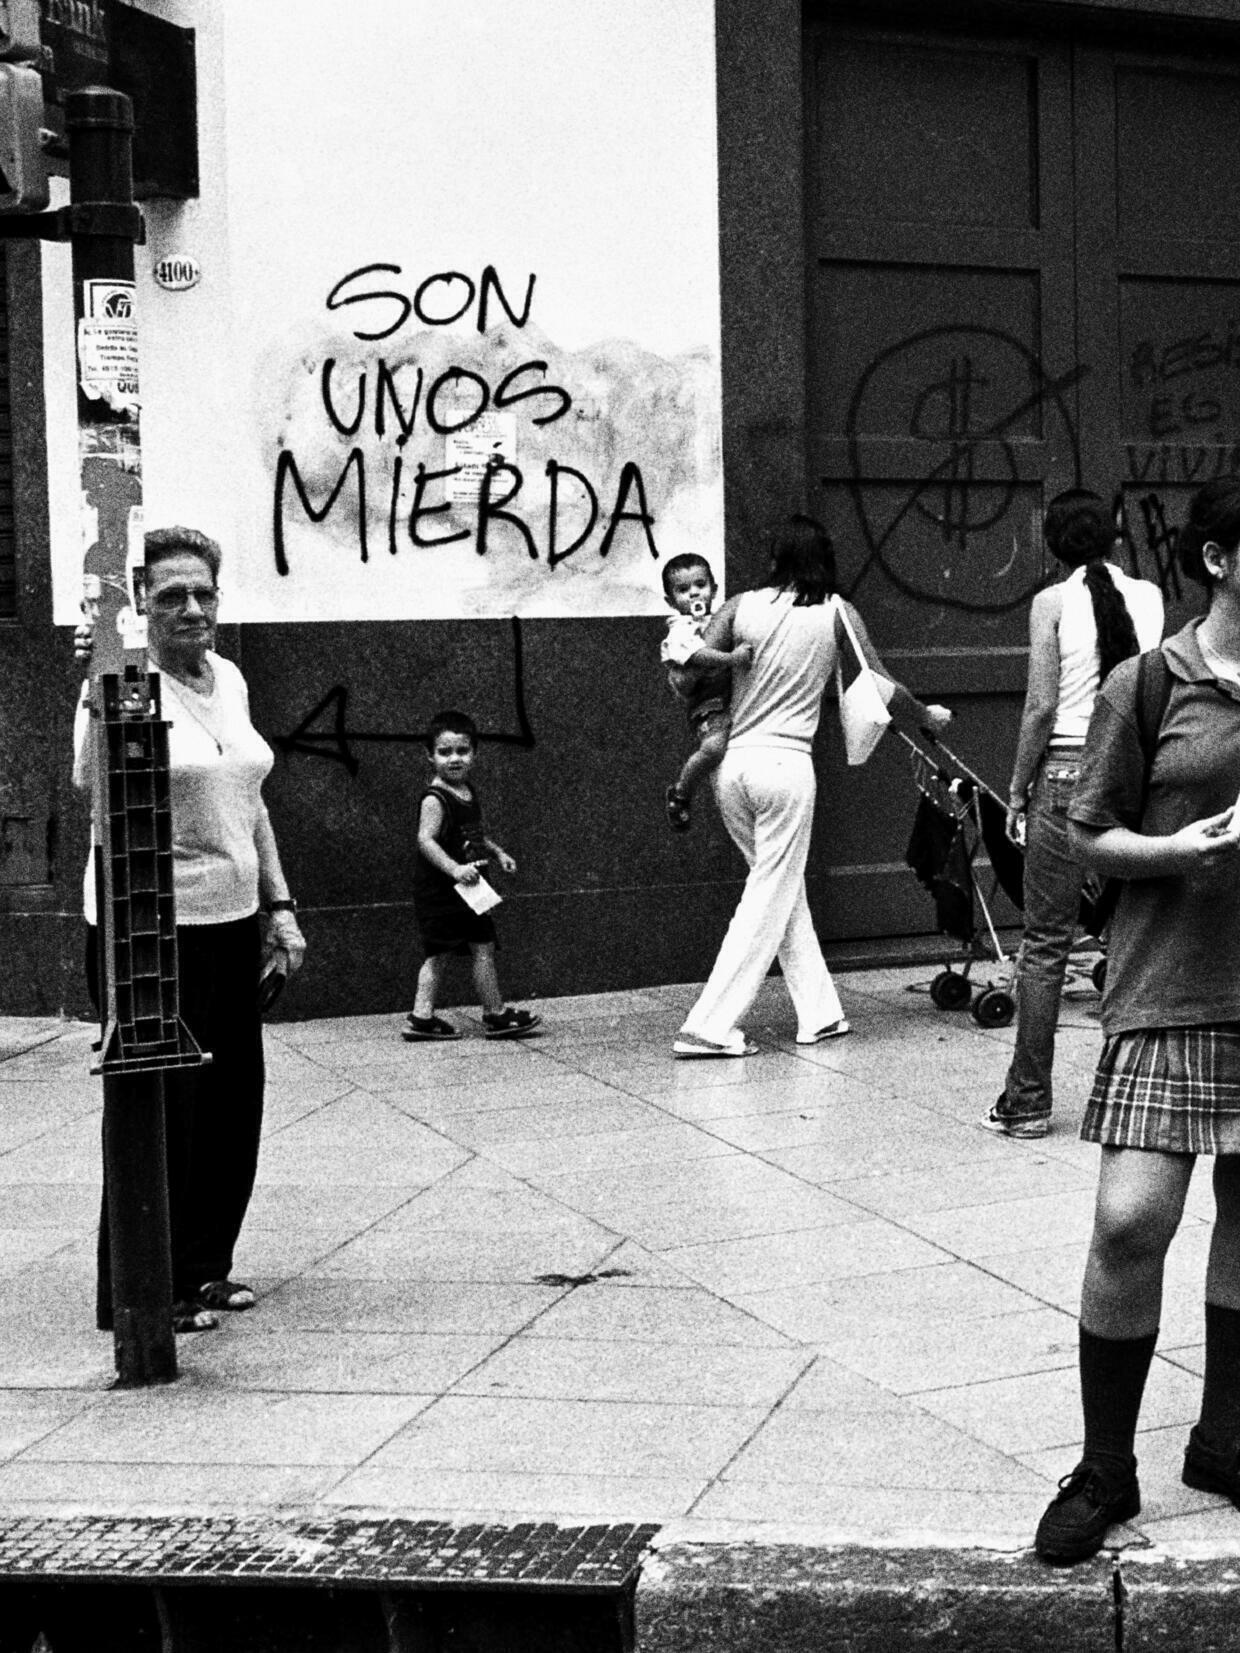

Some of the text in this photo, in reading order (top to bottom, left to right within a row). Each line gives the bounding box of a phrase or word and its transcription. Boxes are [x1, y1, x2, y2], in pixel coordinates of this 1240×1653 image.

[158, 260, 194, 283] 4100
[326, 263, 537, 341] SON
[321, 358, 573, 438] UNOS
[274, 443, 660, 576] MIERDA
